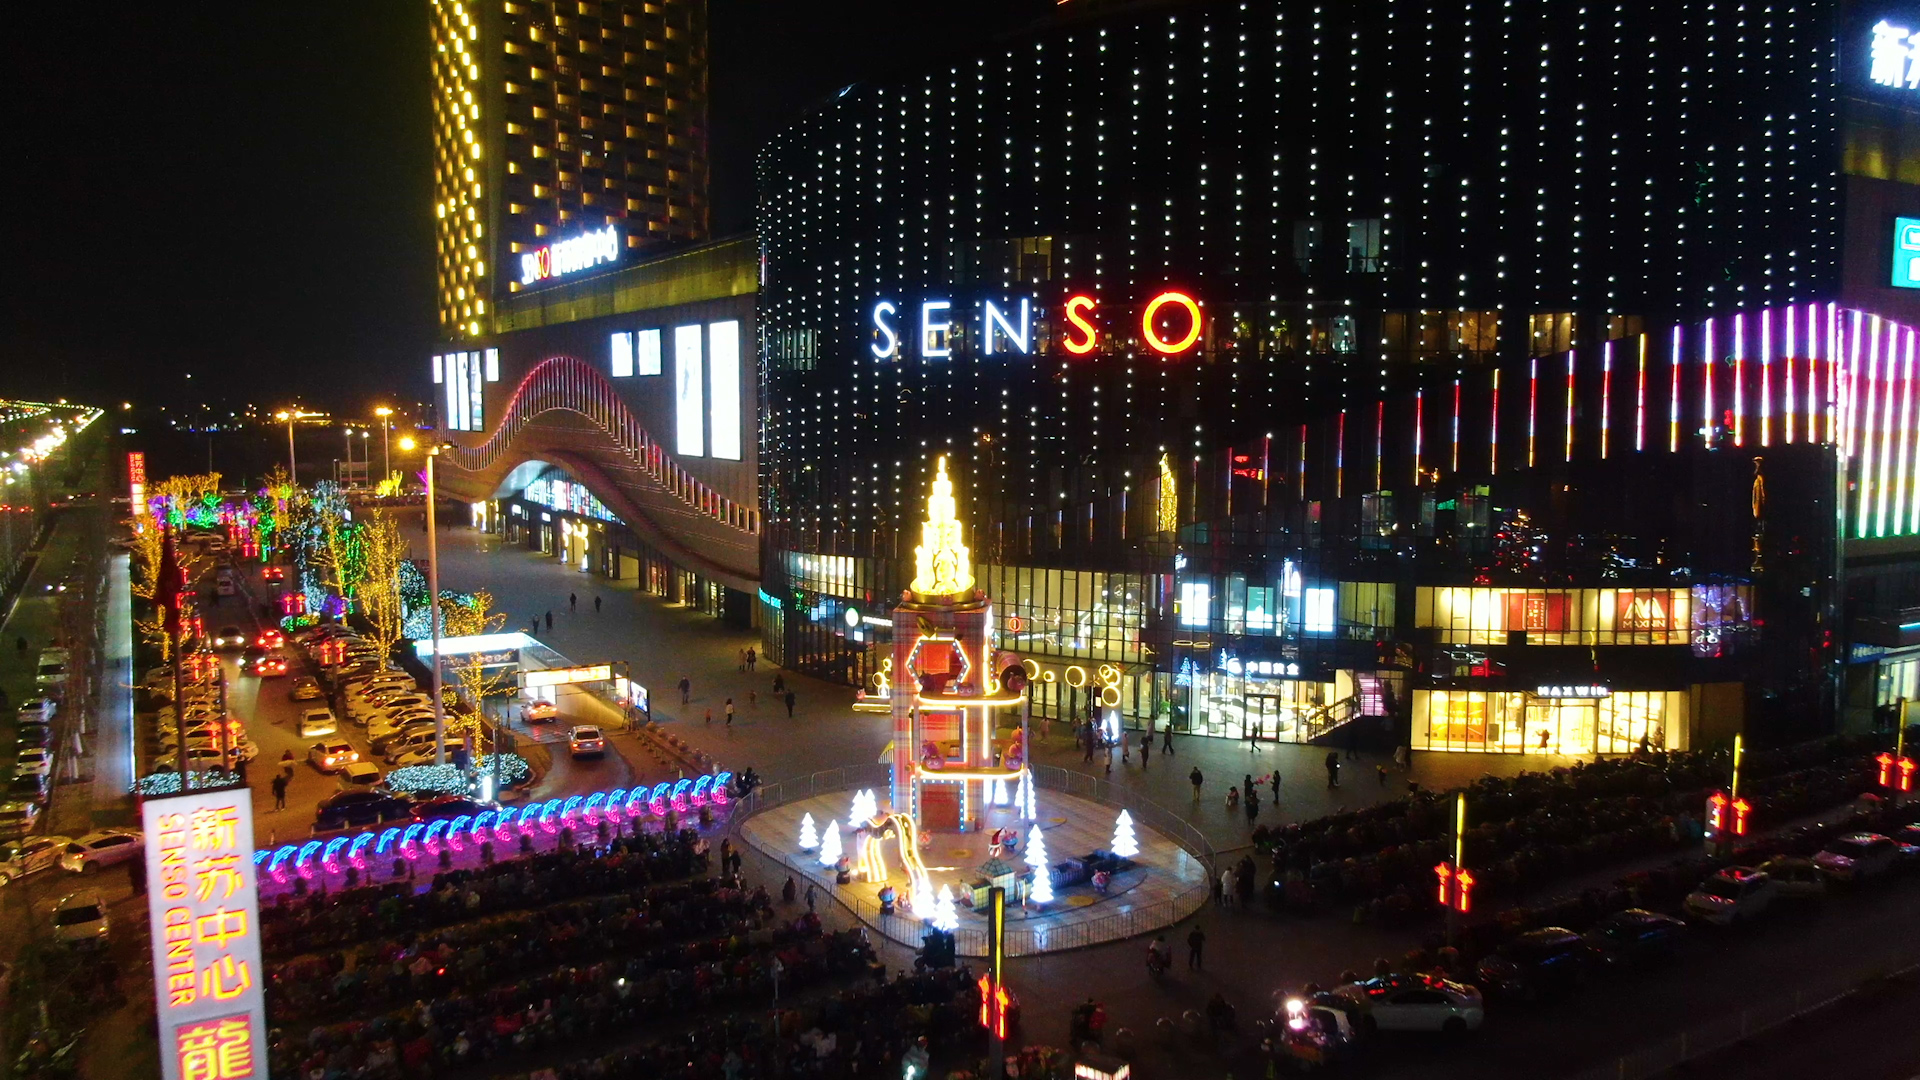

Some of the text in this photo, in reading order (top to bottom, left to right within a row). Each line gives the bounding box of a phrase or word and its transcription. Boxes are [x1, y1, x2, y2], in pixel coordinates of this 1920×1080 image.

[871, 292, 1202, 358] SENSO
[1246, 661, 1299, 675] 中国黄金
[1537, 686, 1608, 696] MAXWIN
[157, 813, 197, 1009] SENSO CENTER
[190, 804, 253, 1002] 新苏中心
